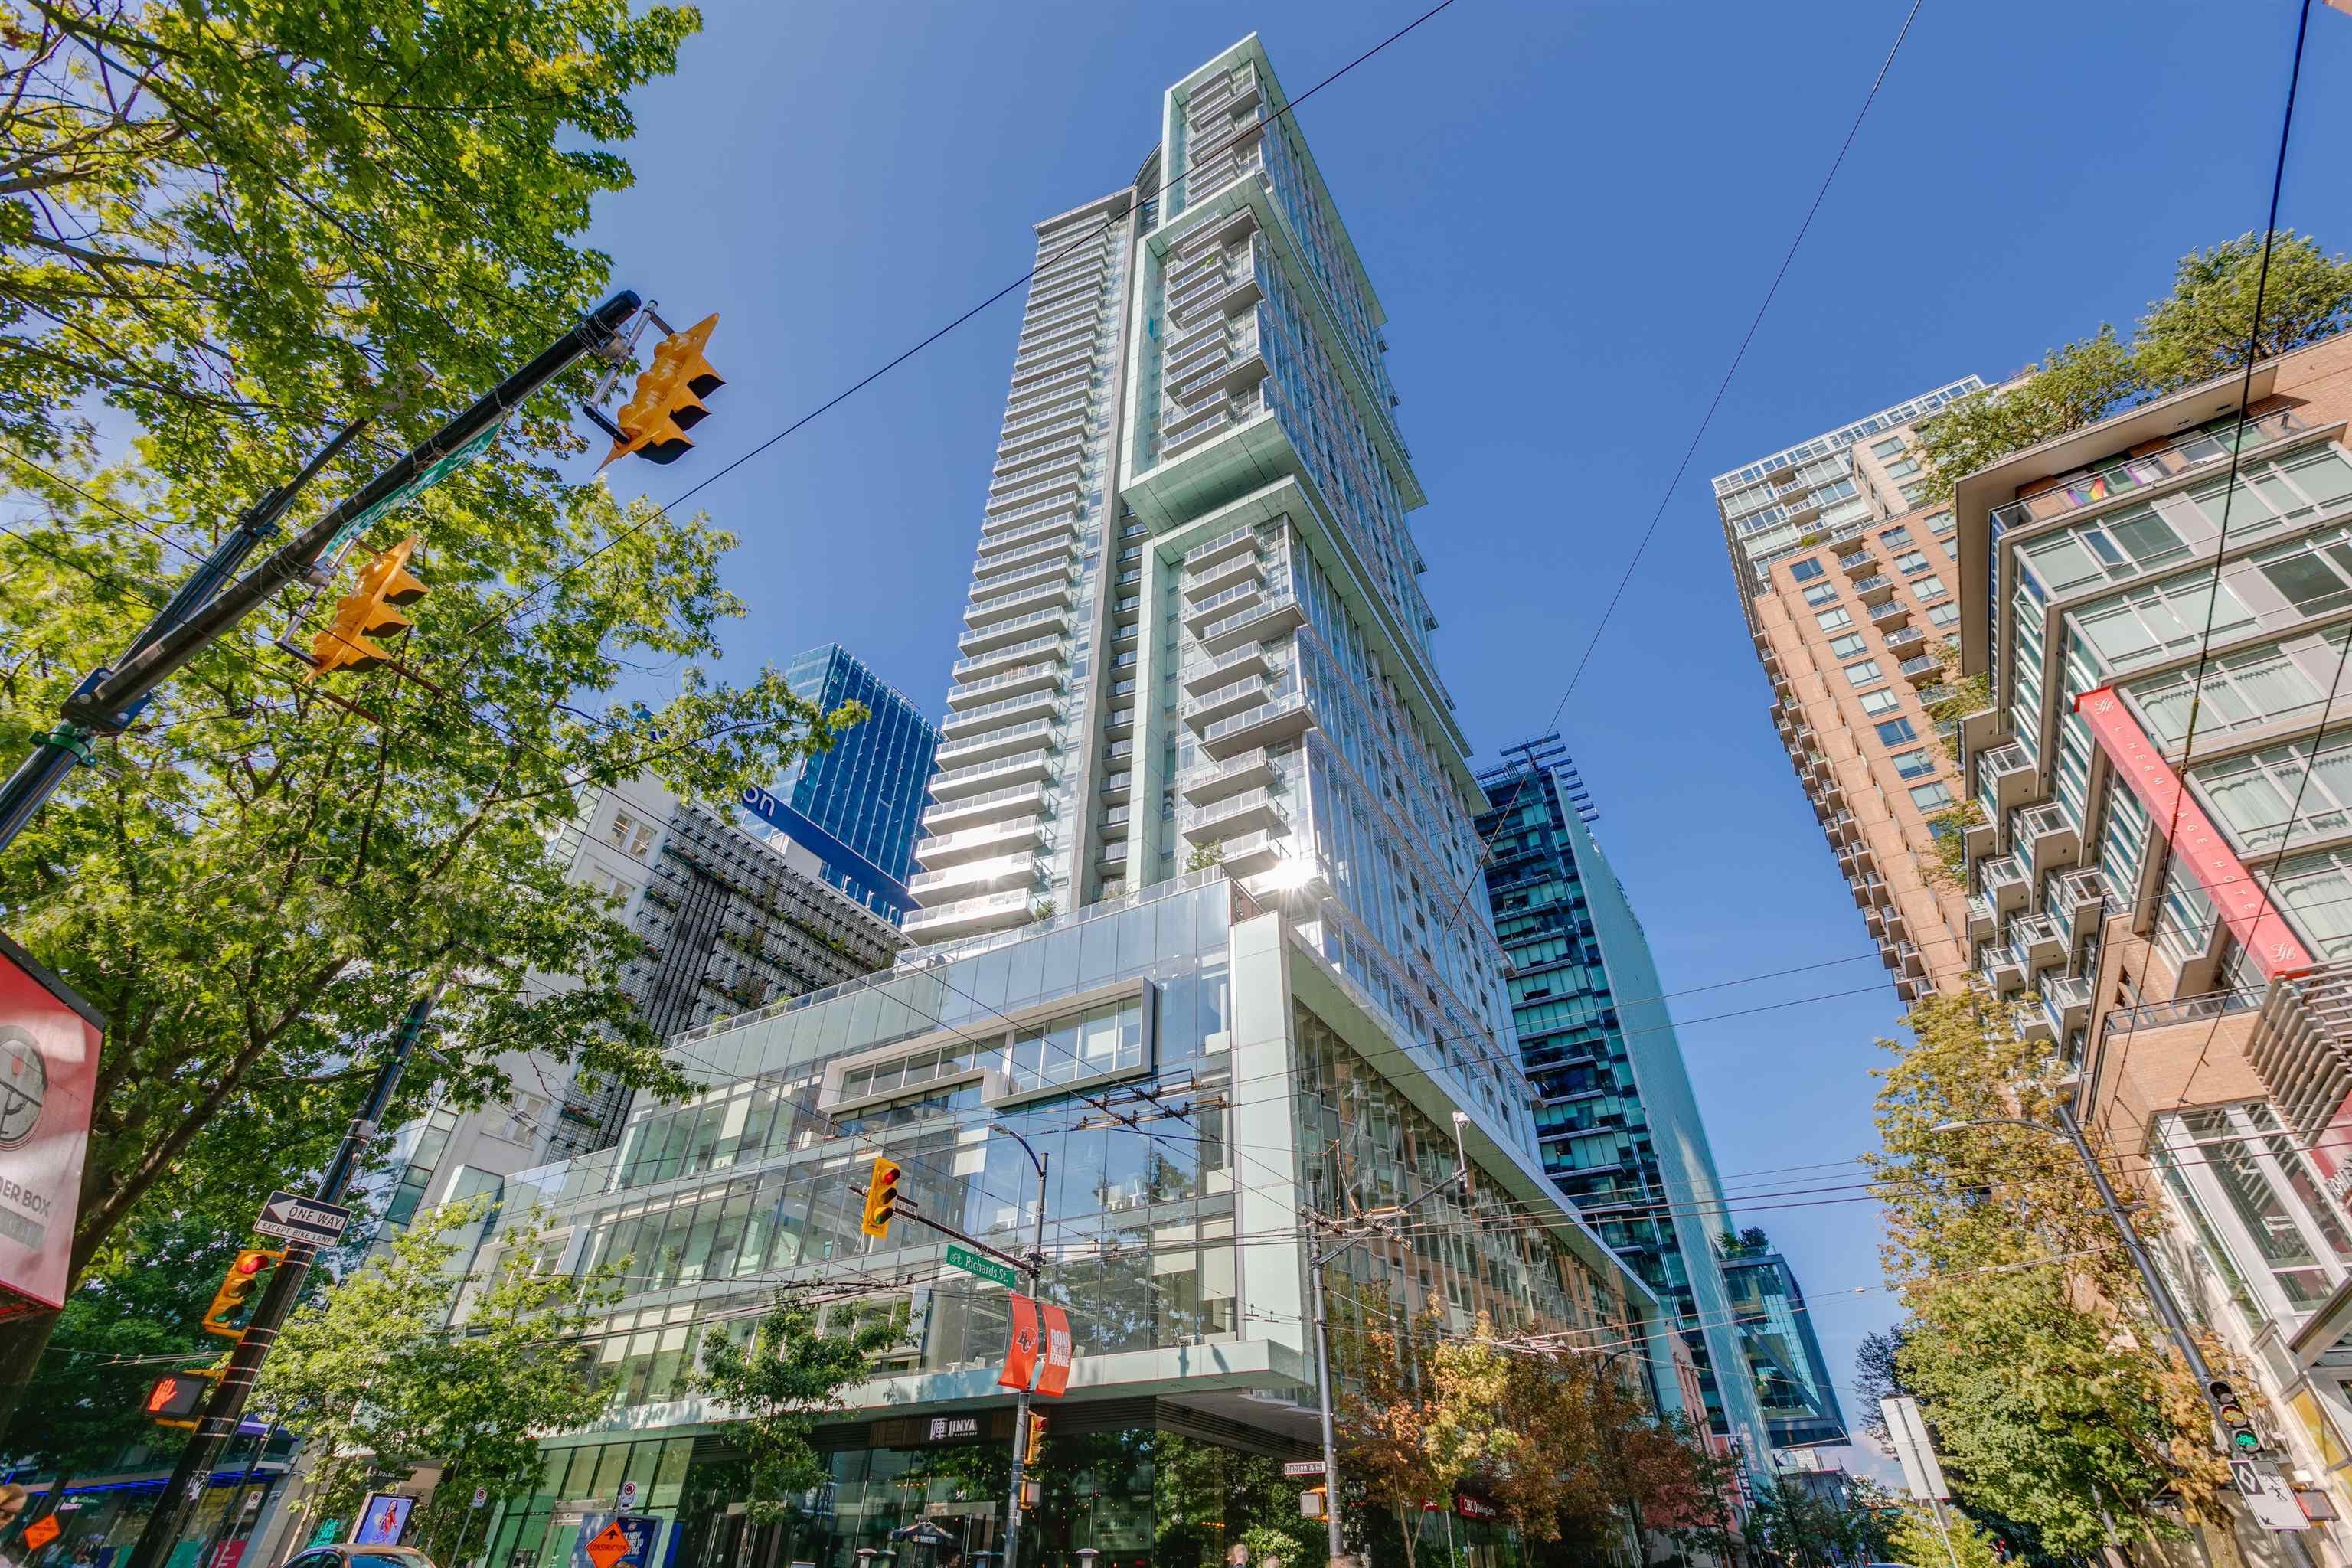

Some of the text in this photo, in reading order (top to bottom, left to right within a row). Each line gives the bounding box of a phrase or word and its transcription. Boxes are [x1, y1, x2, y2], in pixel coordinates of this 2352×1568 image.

[21, 1189, 51, 1218] BOX
[289, 1206, 343, 1228] ONE WAY
[261, 1222, 332, 1244] EXCEPT BIKE LANE
[965, 1255, 1009, 1283] Richards St.
[949, 1419, 977, 1437] JINYA
